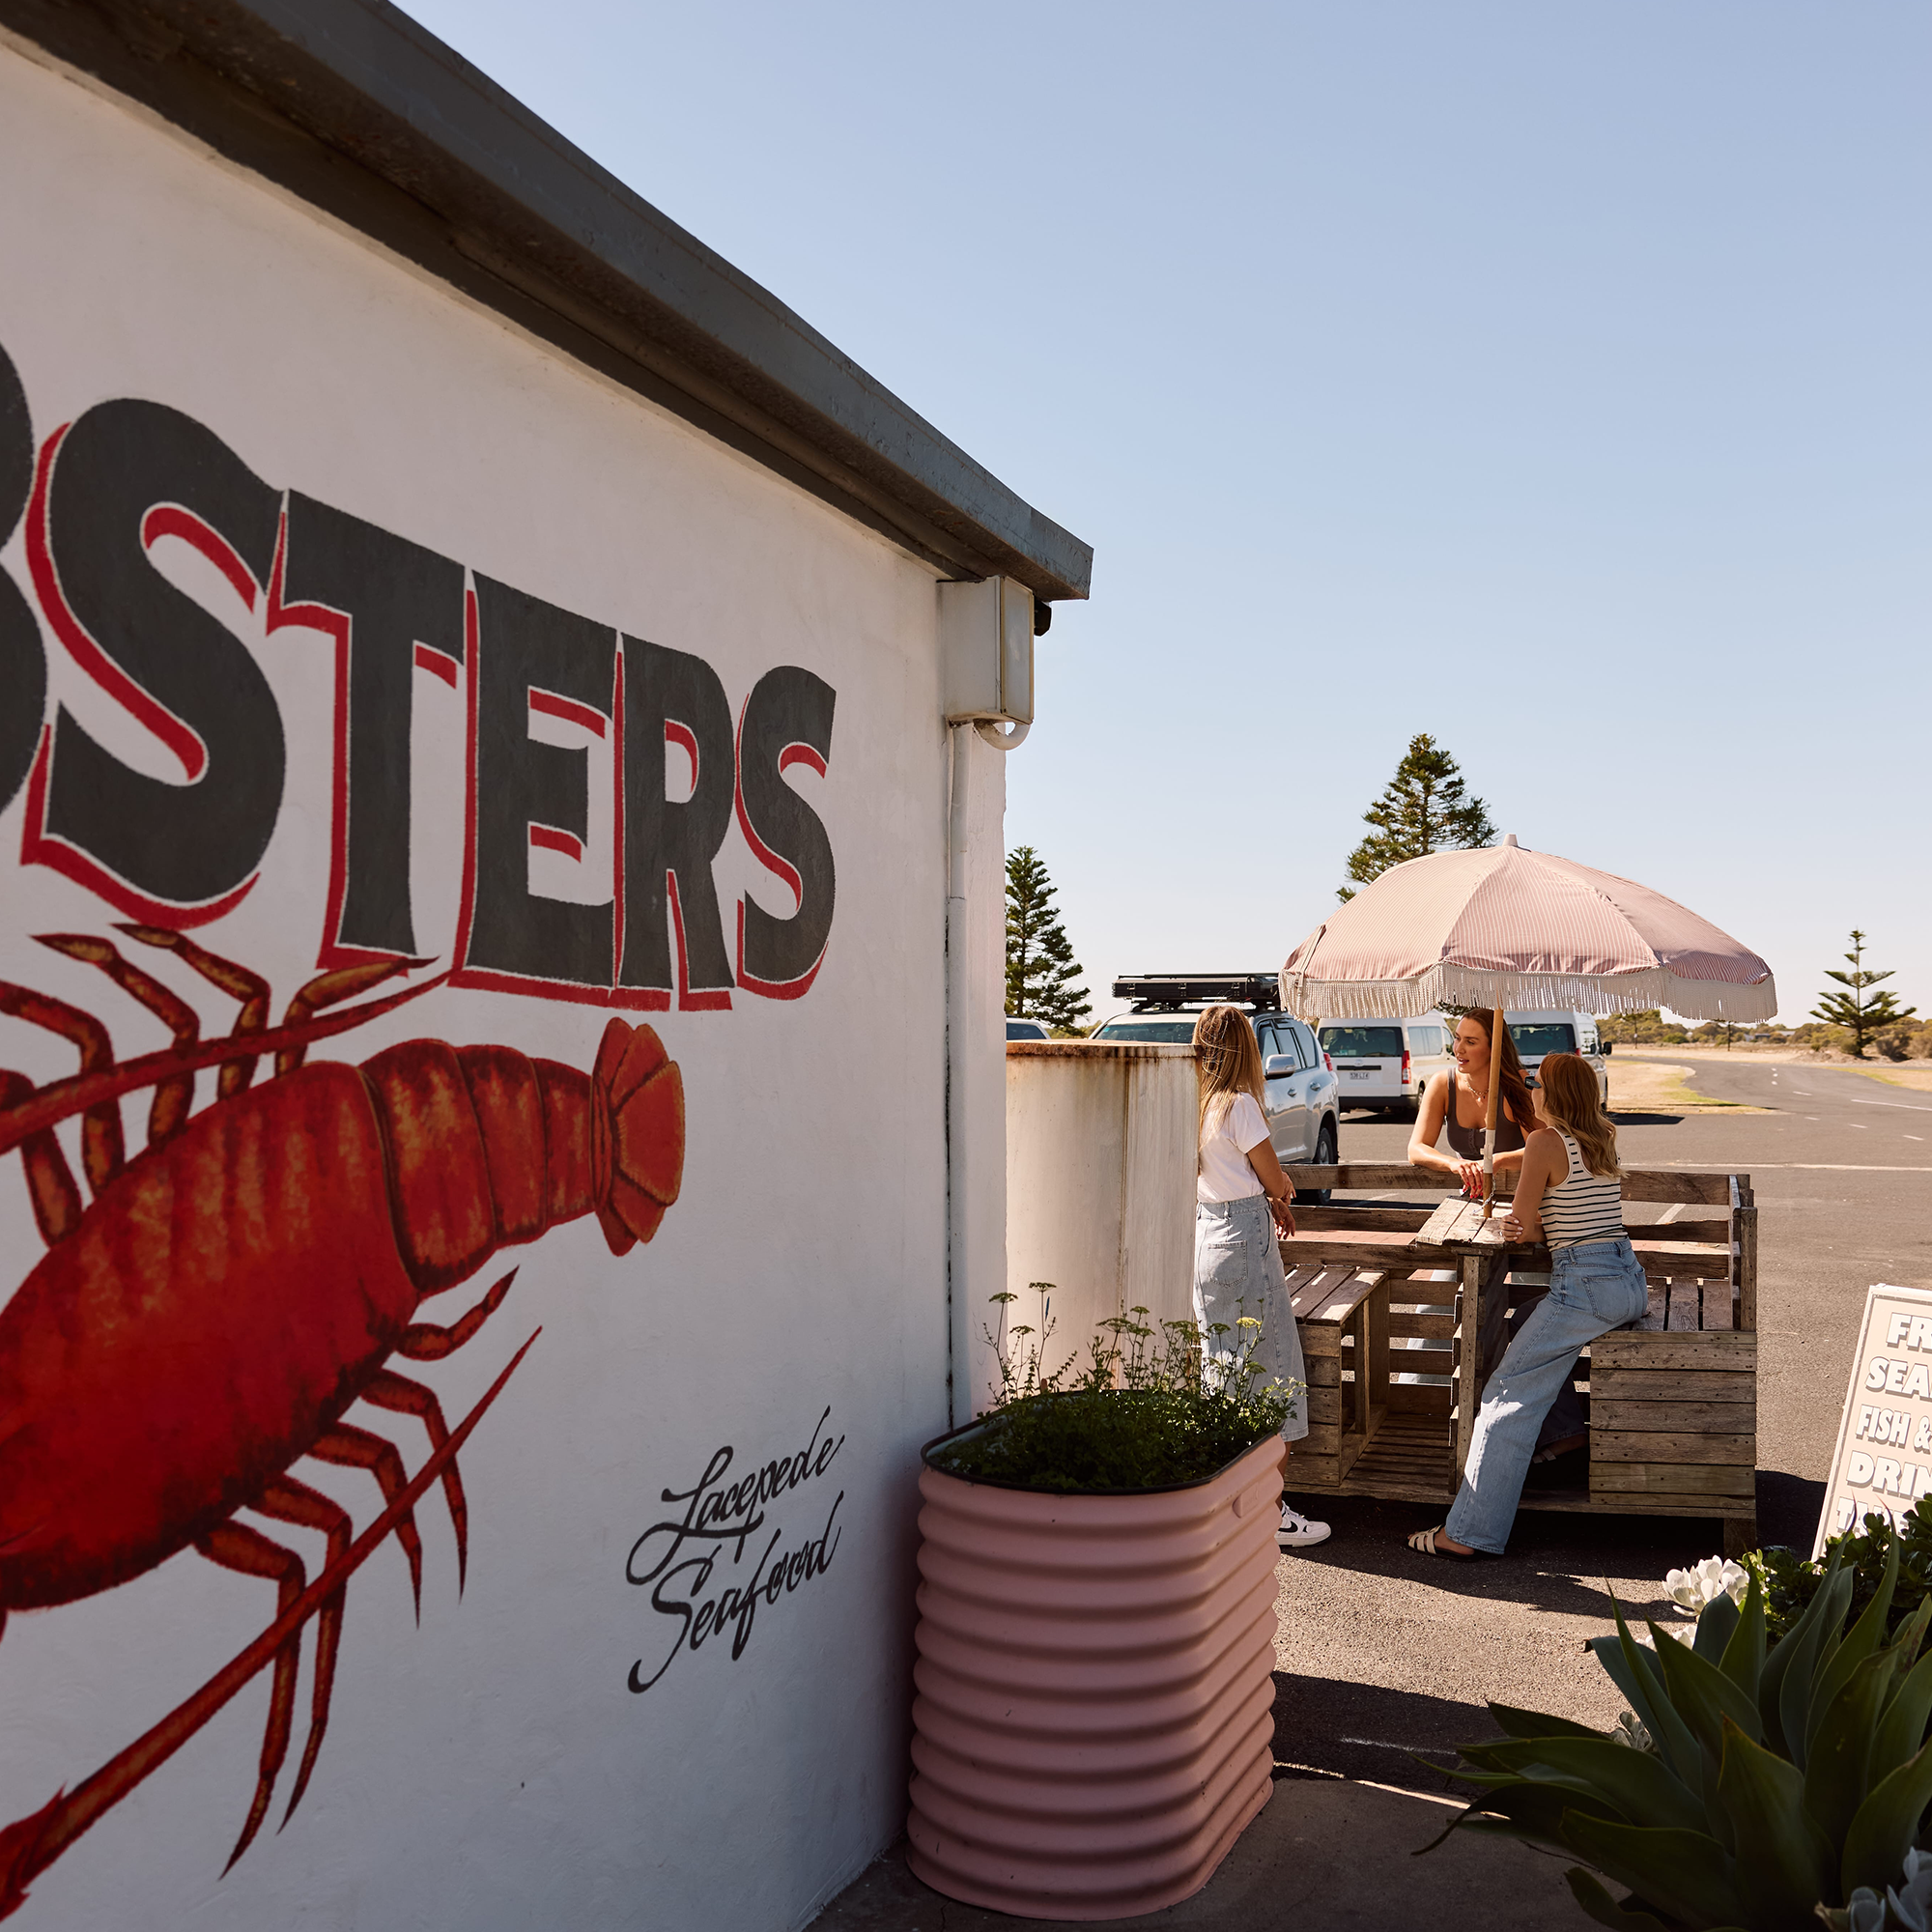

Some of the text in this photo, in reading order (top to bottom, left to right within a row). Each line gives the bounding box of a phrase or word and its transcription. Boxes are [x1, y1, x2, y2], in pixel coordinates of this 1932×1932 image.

[0, 341, 837, 1011] STERS
[1856, 1404, 1932, 1455] FISH &
[1864, 1356, 1932, 1403] SEA
[626, 1406, 845, 1584] Lacepede
[628, 1491, 844, 1693] Seafood
